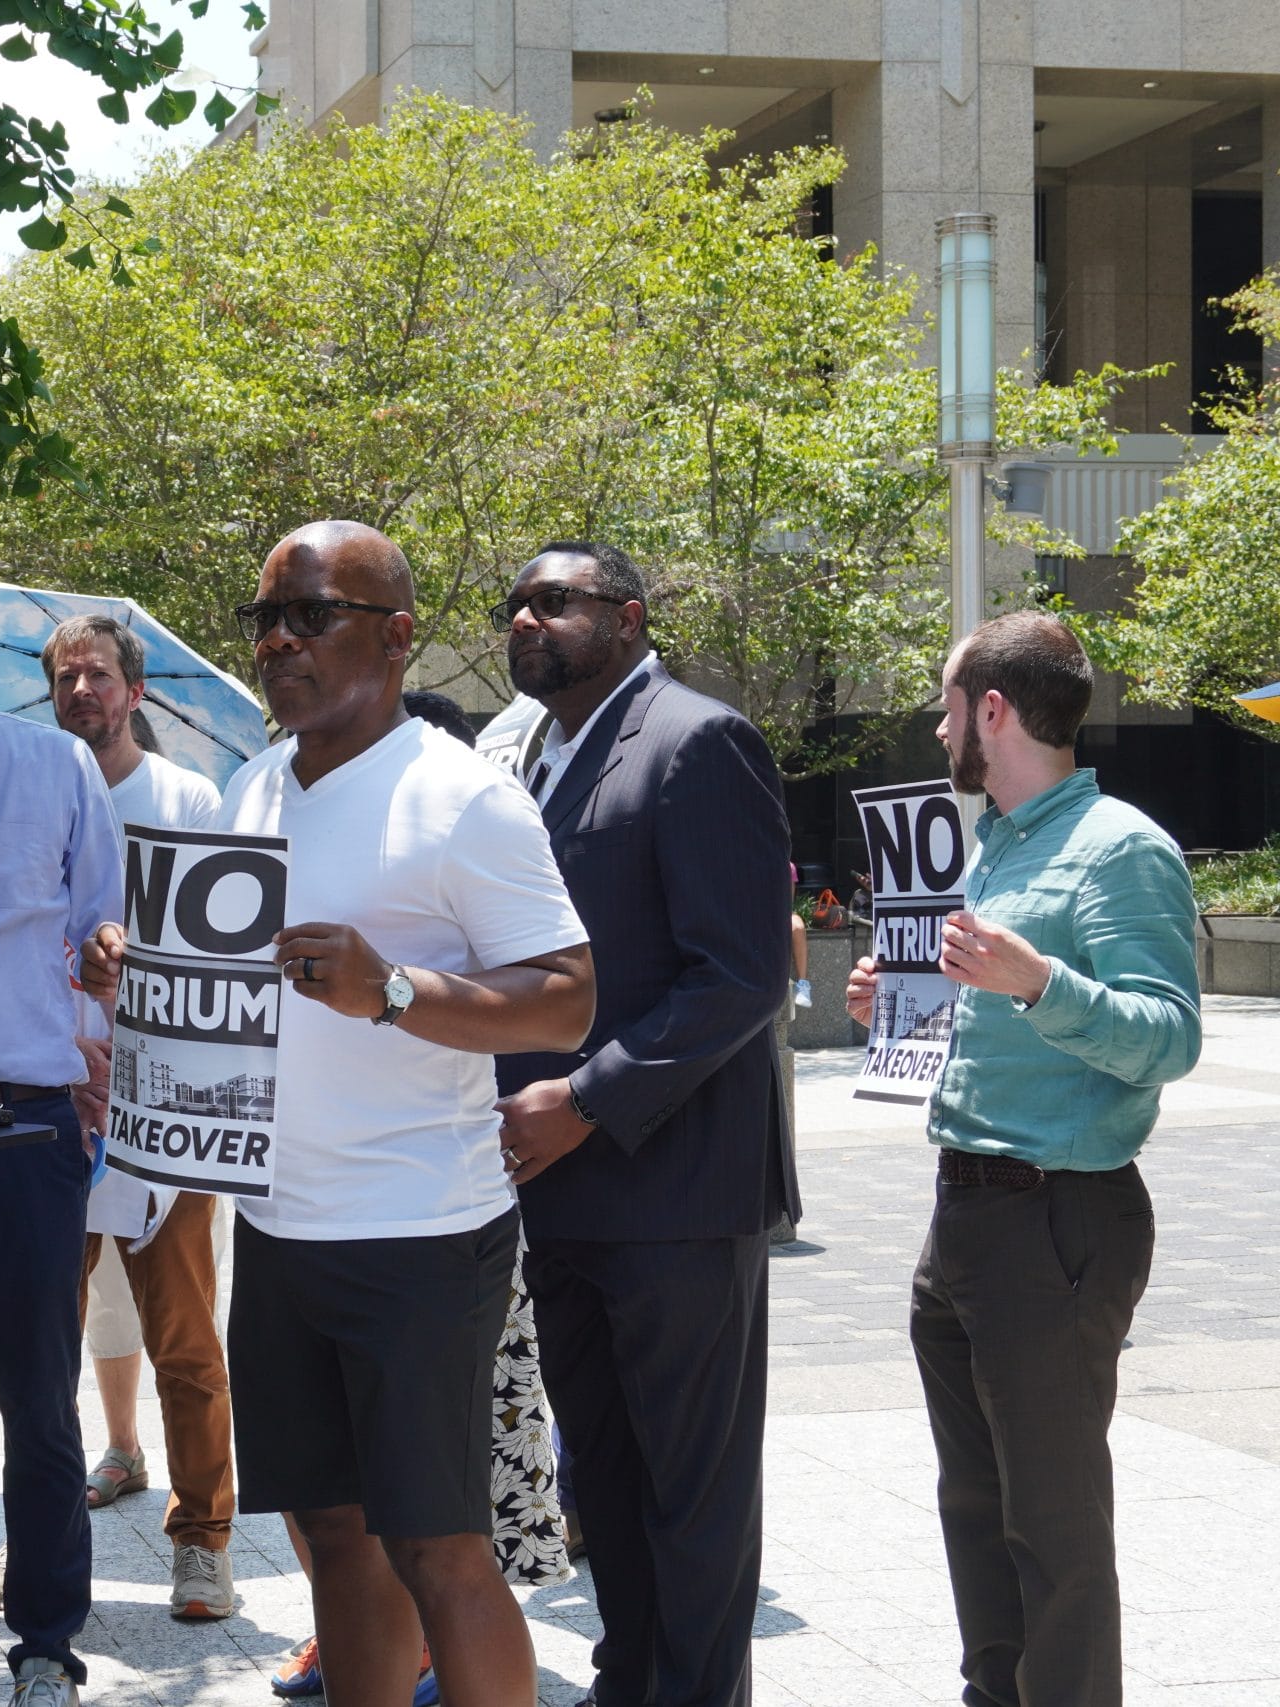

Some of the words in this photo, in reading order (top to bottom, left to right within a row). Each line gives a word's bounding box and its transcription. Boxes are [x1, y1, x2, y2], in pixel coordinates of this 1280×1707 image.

[863, 796, 965, 894] NO
[124, 840, 288, 955] NO
[874, 916, 947, 963] ATRIU
[116, 968, 279, 1035] ATRIUM
[863, 1047, 943, 1083] TAKEOVER
[110, 1105, 271, 1168] TAKEOVER
